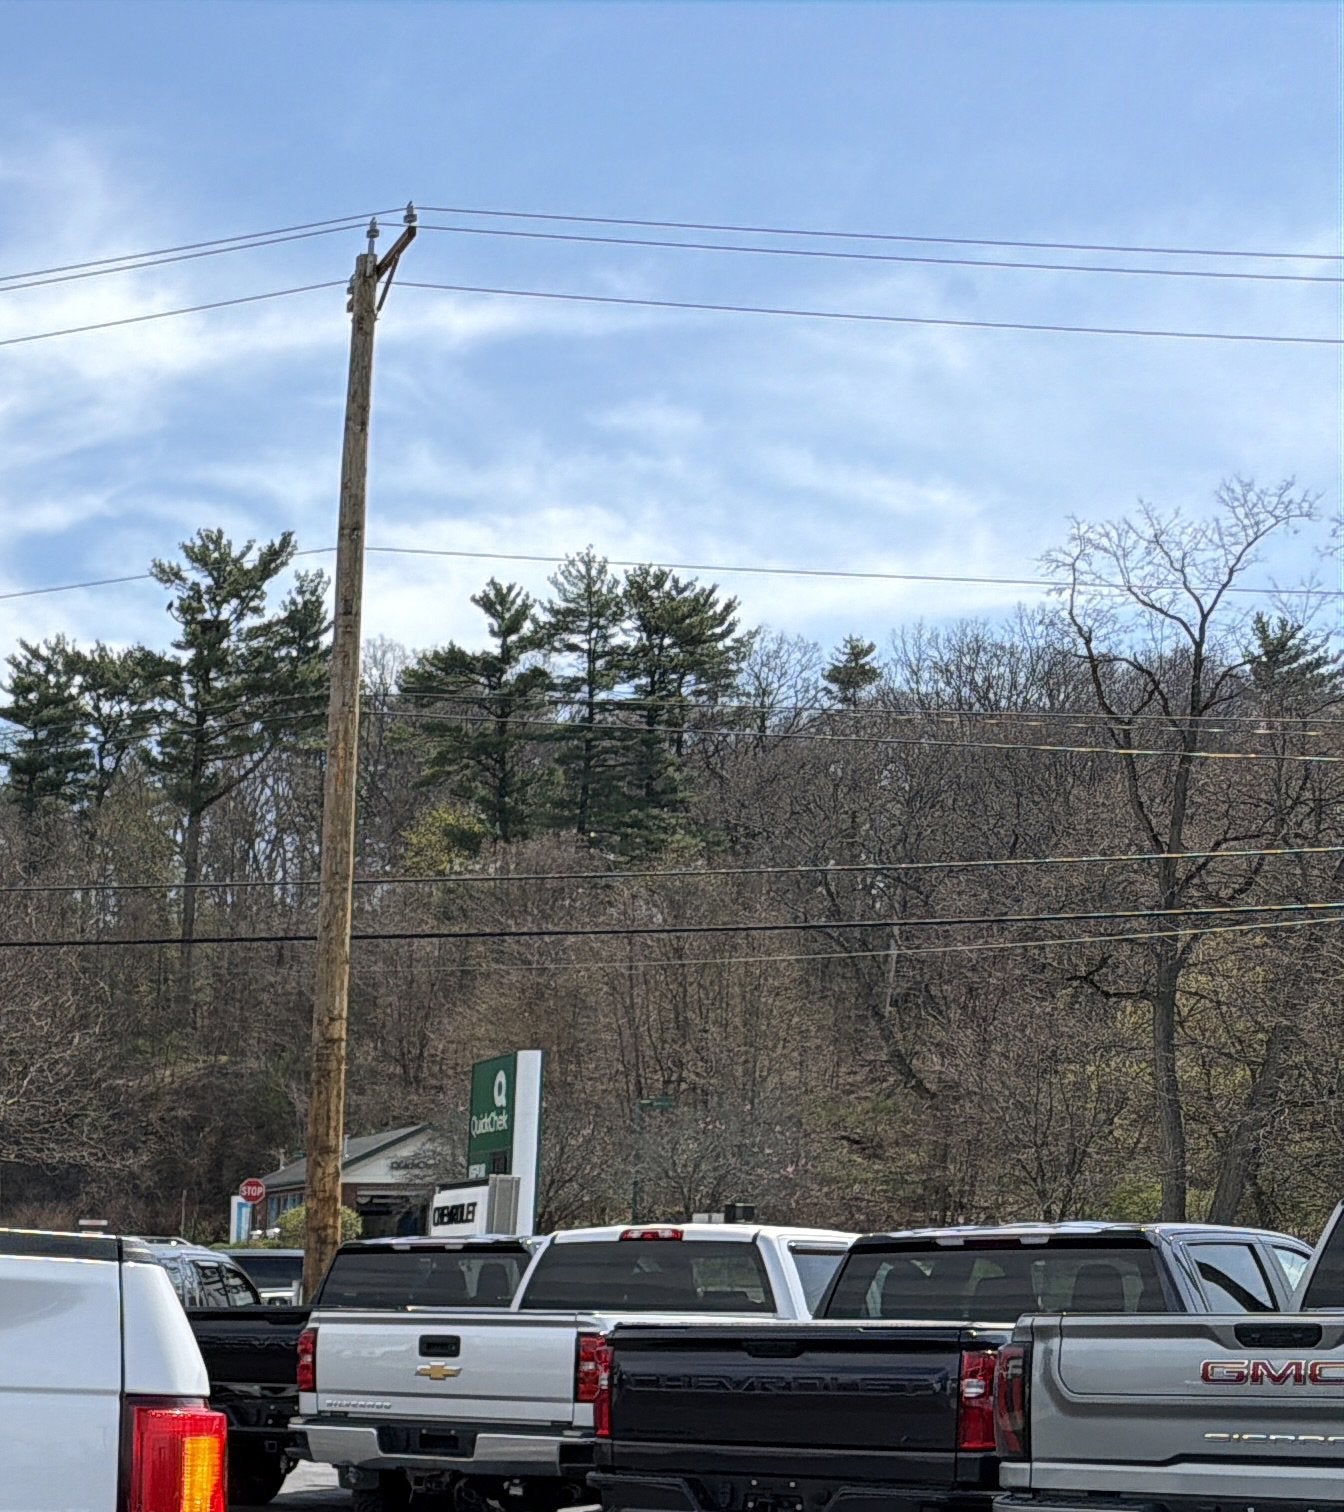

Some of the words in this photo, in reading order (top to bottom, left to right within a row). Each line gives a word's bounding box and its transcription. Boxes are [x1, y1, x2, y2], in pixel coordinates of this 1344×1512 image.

[470, 1110, 509, 1138] QuickChek
[241, 1186, 263, 1196] STOP
[1200, 1359, 1344, 1386] GMC
